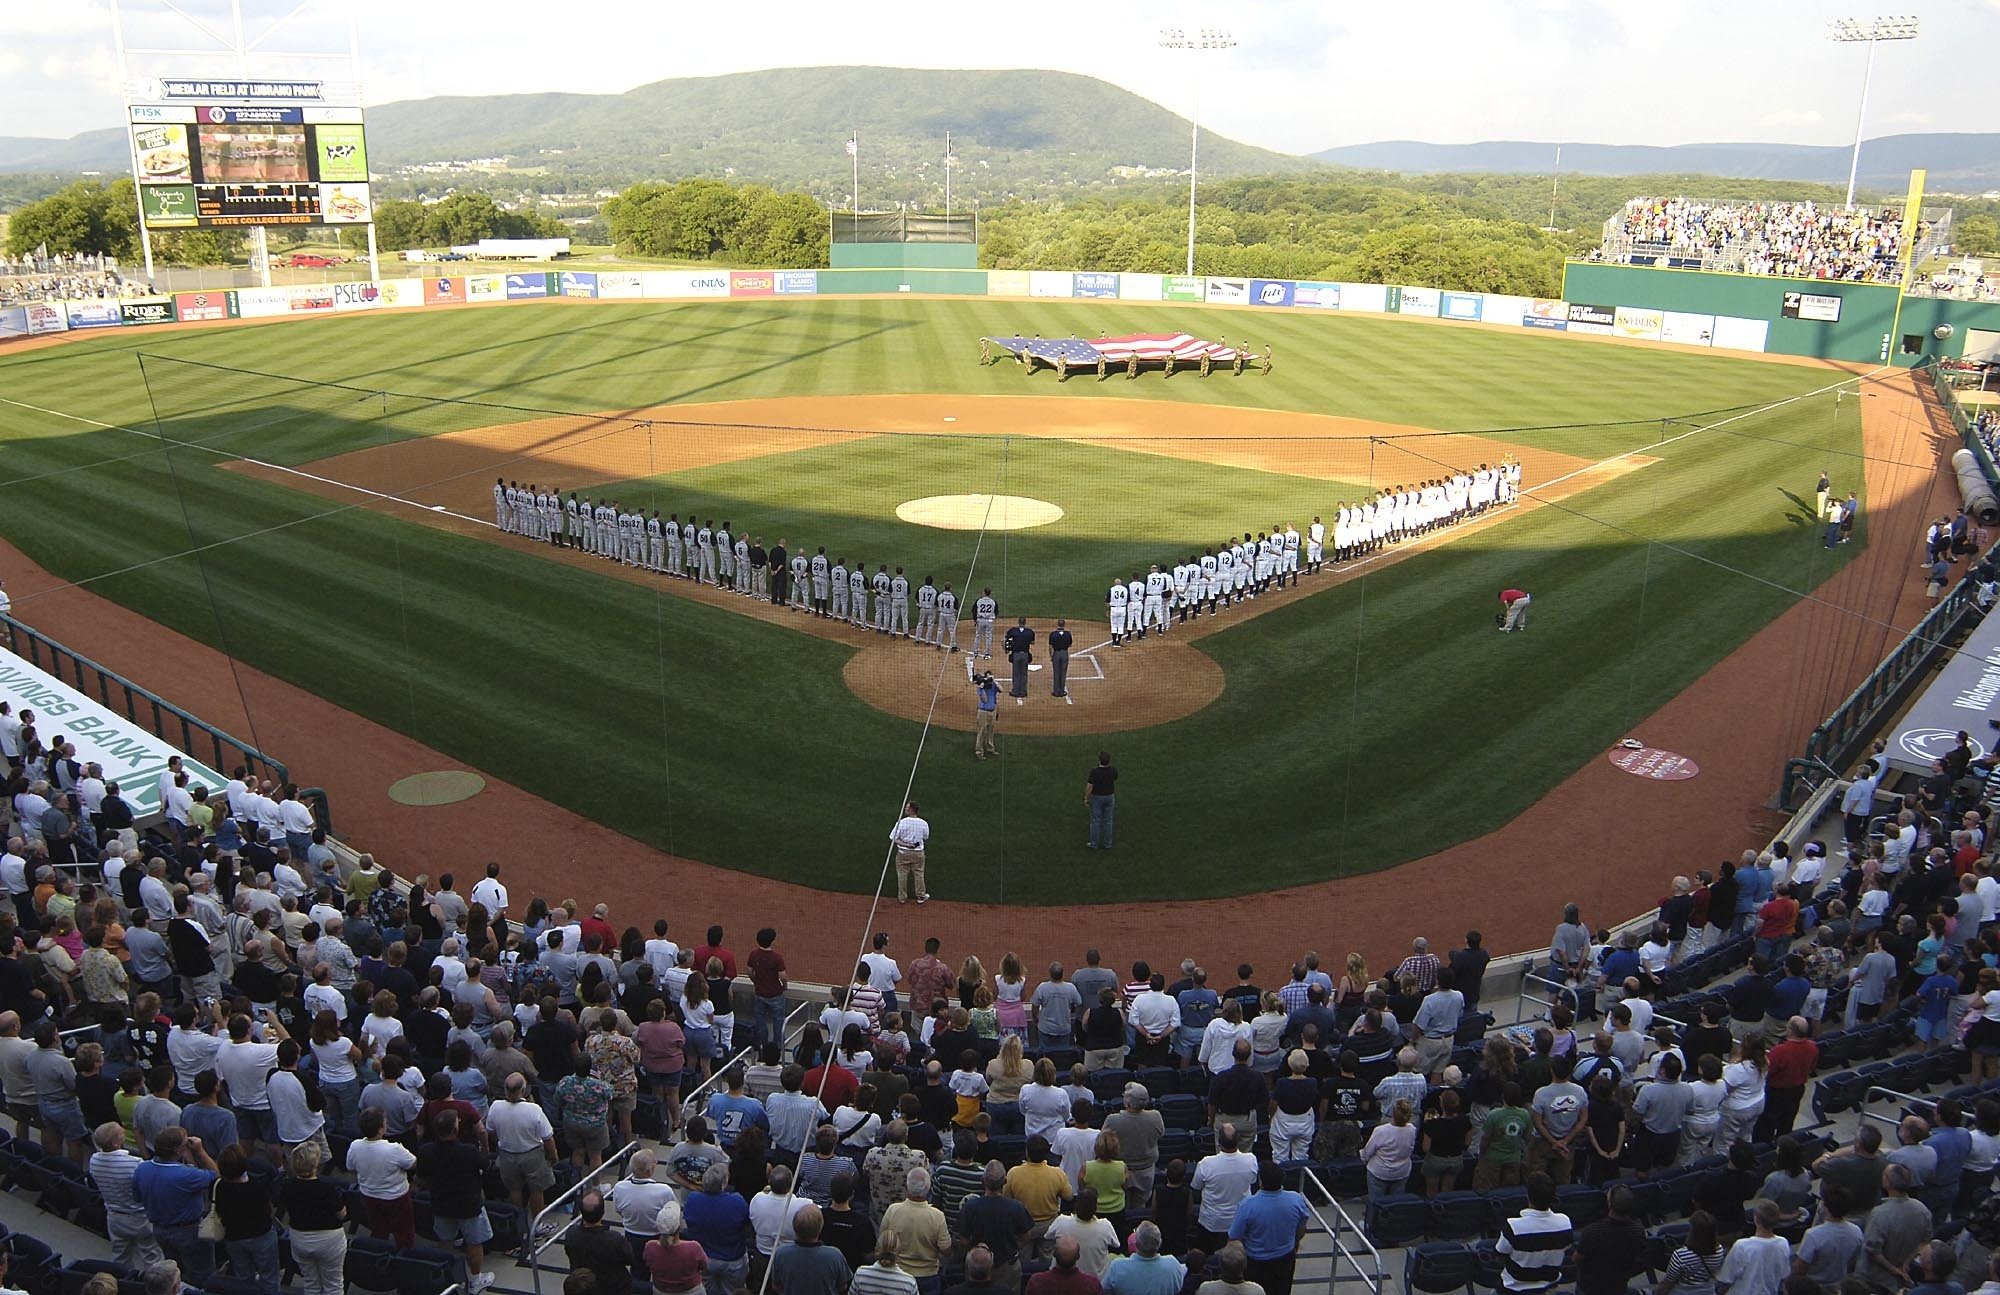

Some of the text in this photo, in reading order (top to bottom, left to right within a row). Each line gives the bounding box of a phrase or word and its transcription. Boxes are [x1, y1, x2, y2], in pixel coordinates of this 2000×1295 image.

[209, 84, 235, 95] FIELD
[237, 84, 250, 96] AT
[293, 85, 318, 97] PARK
[134, 108, 161, 117] FISK
[211, 217, 239, 225] STATE
[240, 216, 279, 224] COLLEGE
[691, 278, 726, 289] CINTAS
[334, 283, 375, 304] PSECU
[1204, 561, 1214, 569] 40
[1222, 556, 1230, 565] 12
[813, 562, 824, 572] 29
[835, 572, 841, 580] 2
[1179, 571, 1184, 579] 7
[851, 578, 861, 588] 25
[1151, 577, 1161, 586] 57
[896, 583, 902, 592] 3
[1134, 587, 1140, 596] 4
[922, 592, 933, 602] 17
[1114, 590, 1125, 599] 34
[940, 599, 951, 609] 14
[979, 604, 992, 613] 22
[1952, 674, 2000, 711] Welcome
[0, 663, 163, 768] AVINGS BANK
